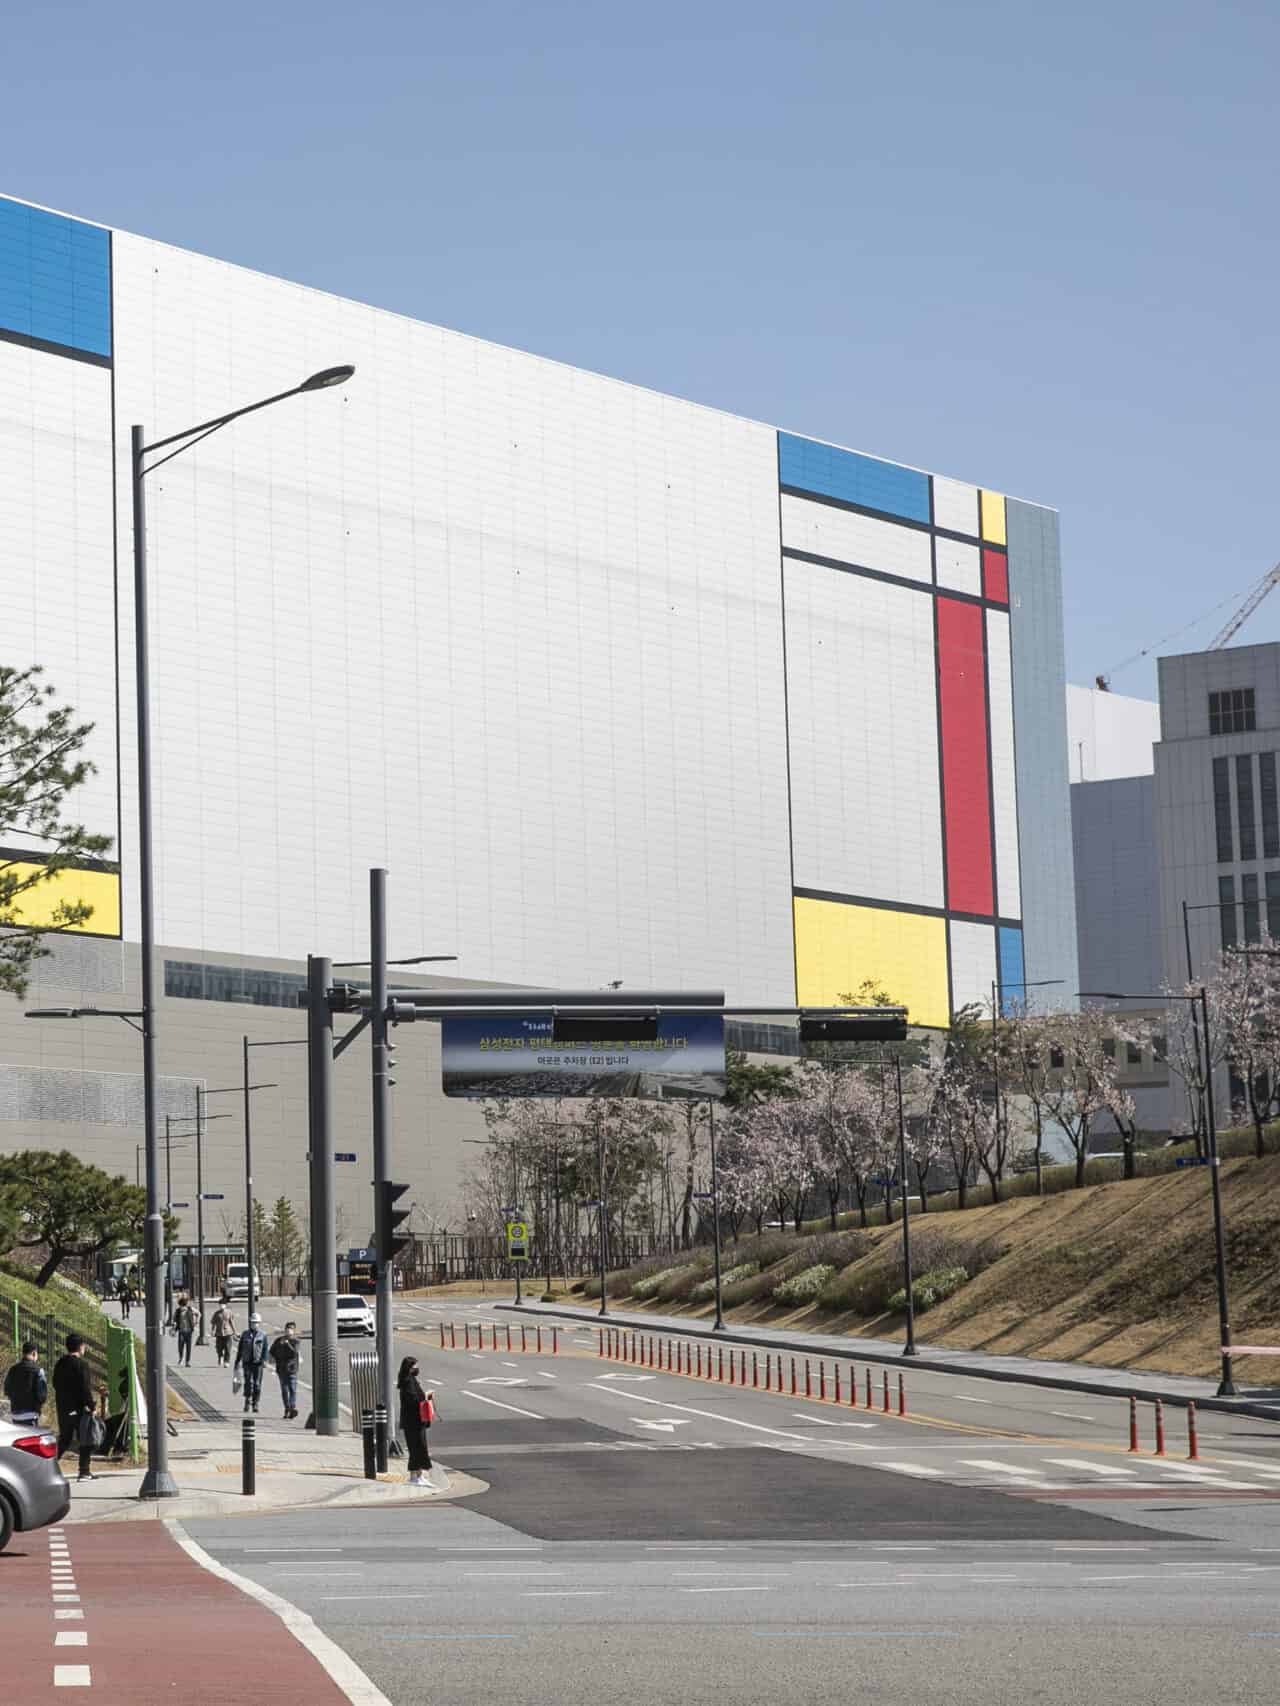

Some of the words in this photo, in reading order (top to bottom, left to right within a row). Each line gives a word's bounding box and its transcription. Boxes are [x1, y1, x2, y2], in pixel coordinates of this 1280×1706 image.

[480, 1037, 525, 1051] 삼성전자
[606, 1056, 629, 1066] 입니다
[359, 1250, 368, 1260] P
